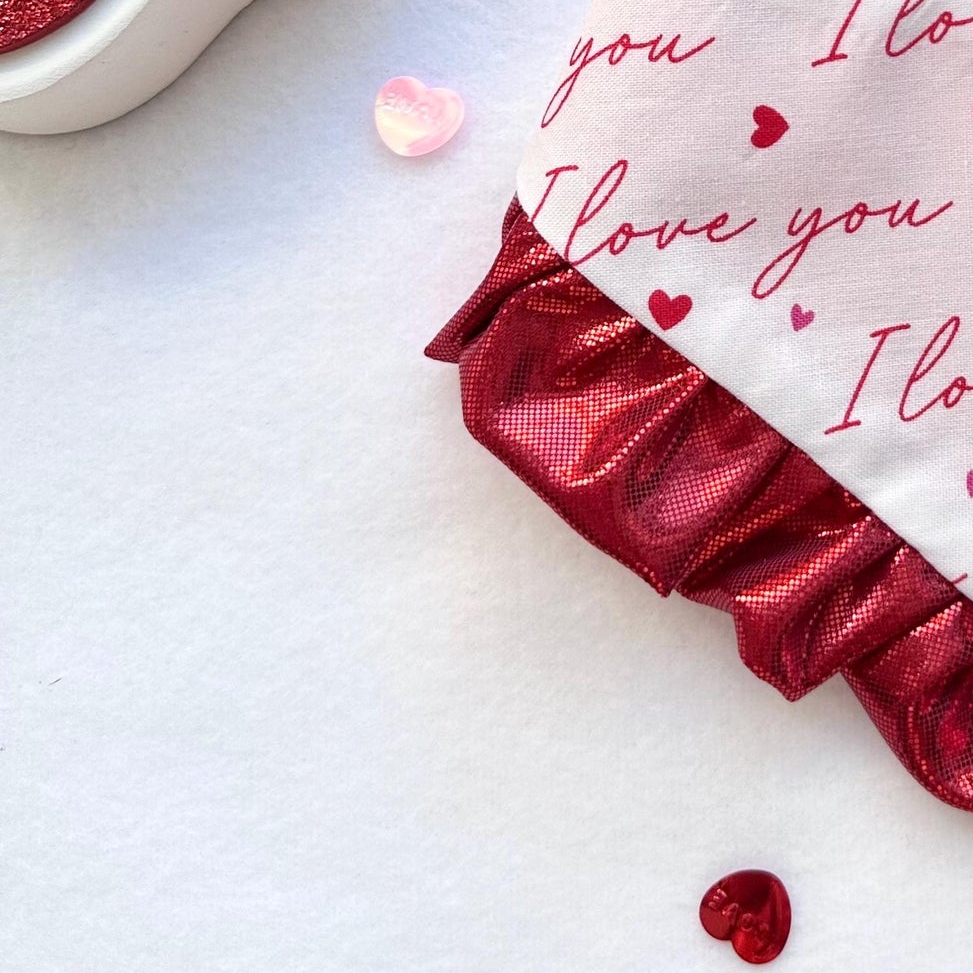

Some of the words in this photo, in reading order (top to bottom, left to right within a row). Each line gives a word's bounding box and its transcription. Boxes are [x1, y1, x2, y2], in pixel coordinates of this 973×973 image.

[540, 30, 717, 130] you
[563, 158, 758, 267] love
[751, 197, 956, 300] you
[823, 323, 912, 436] I
